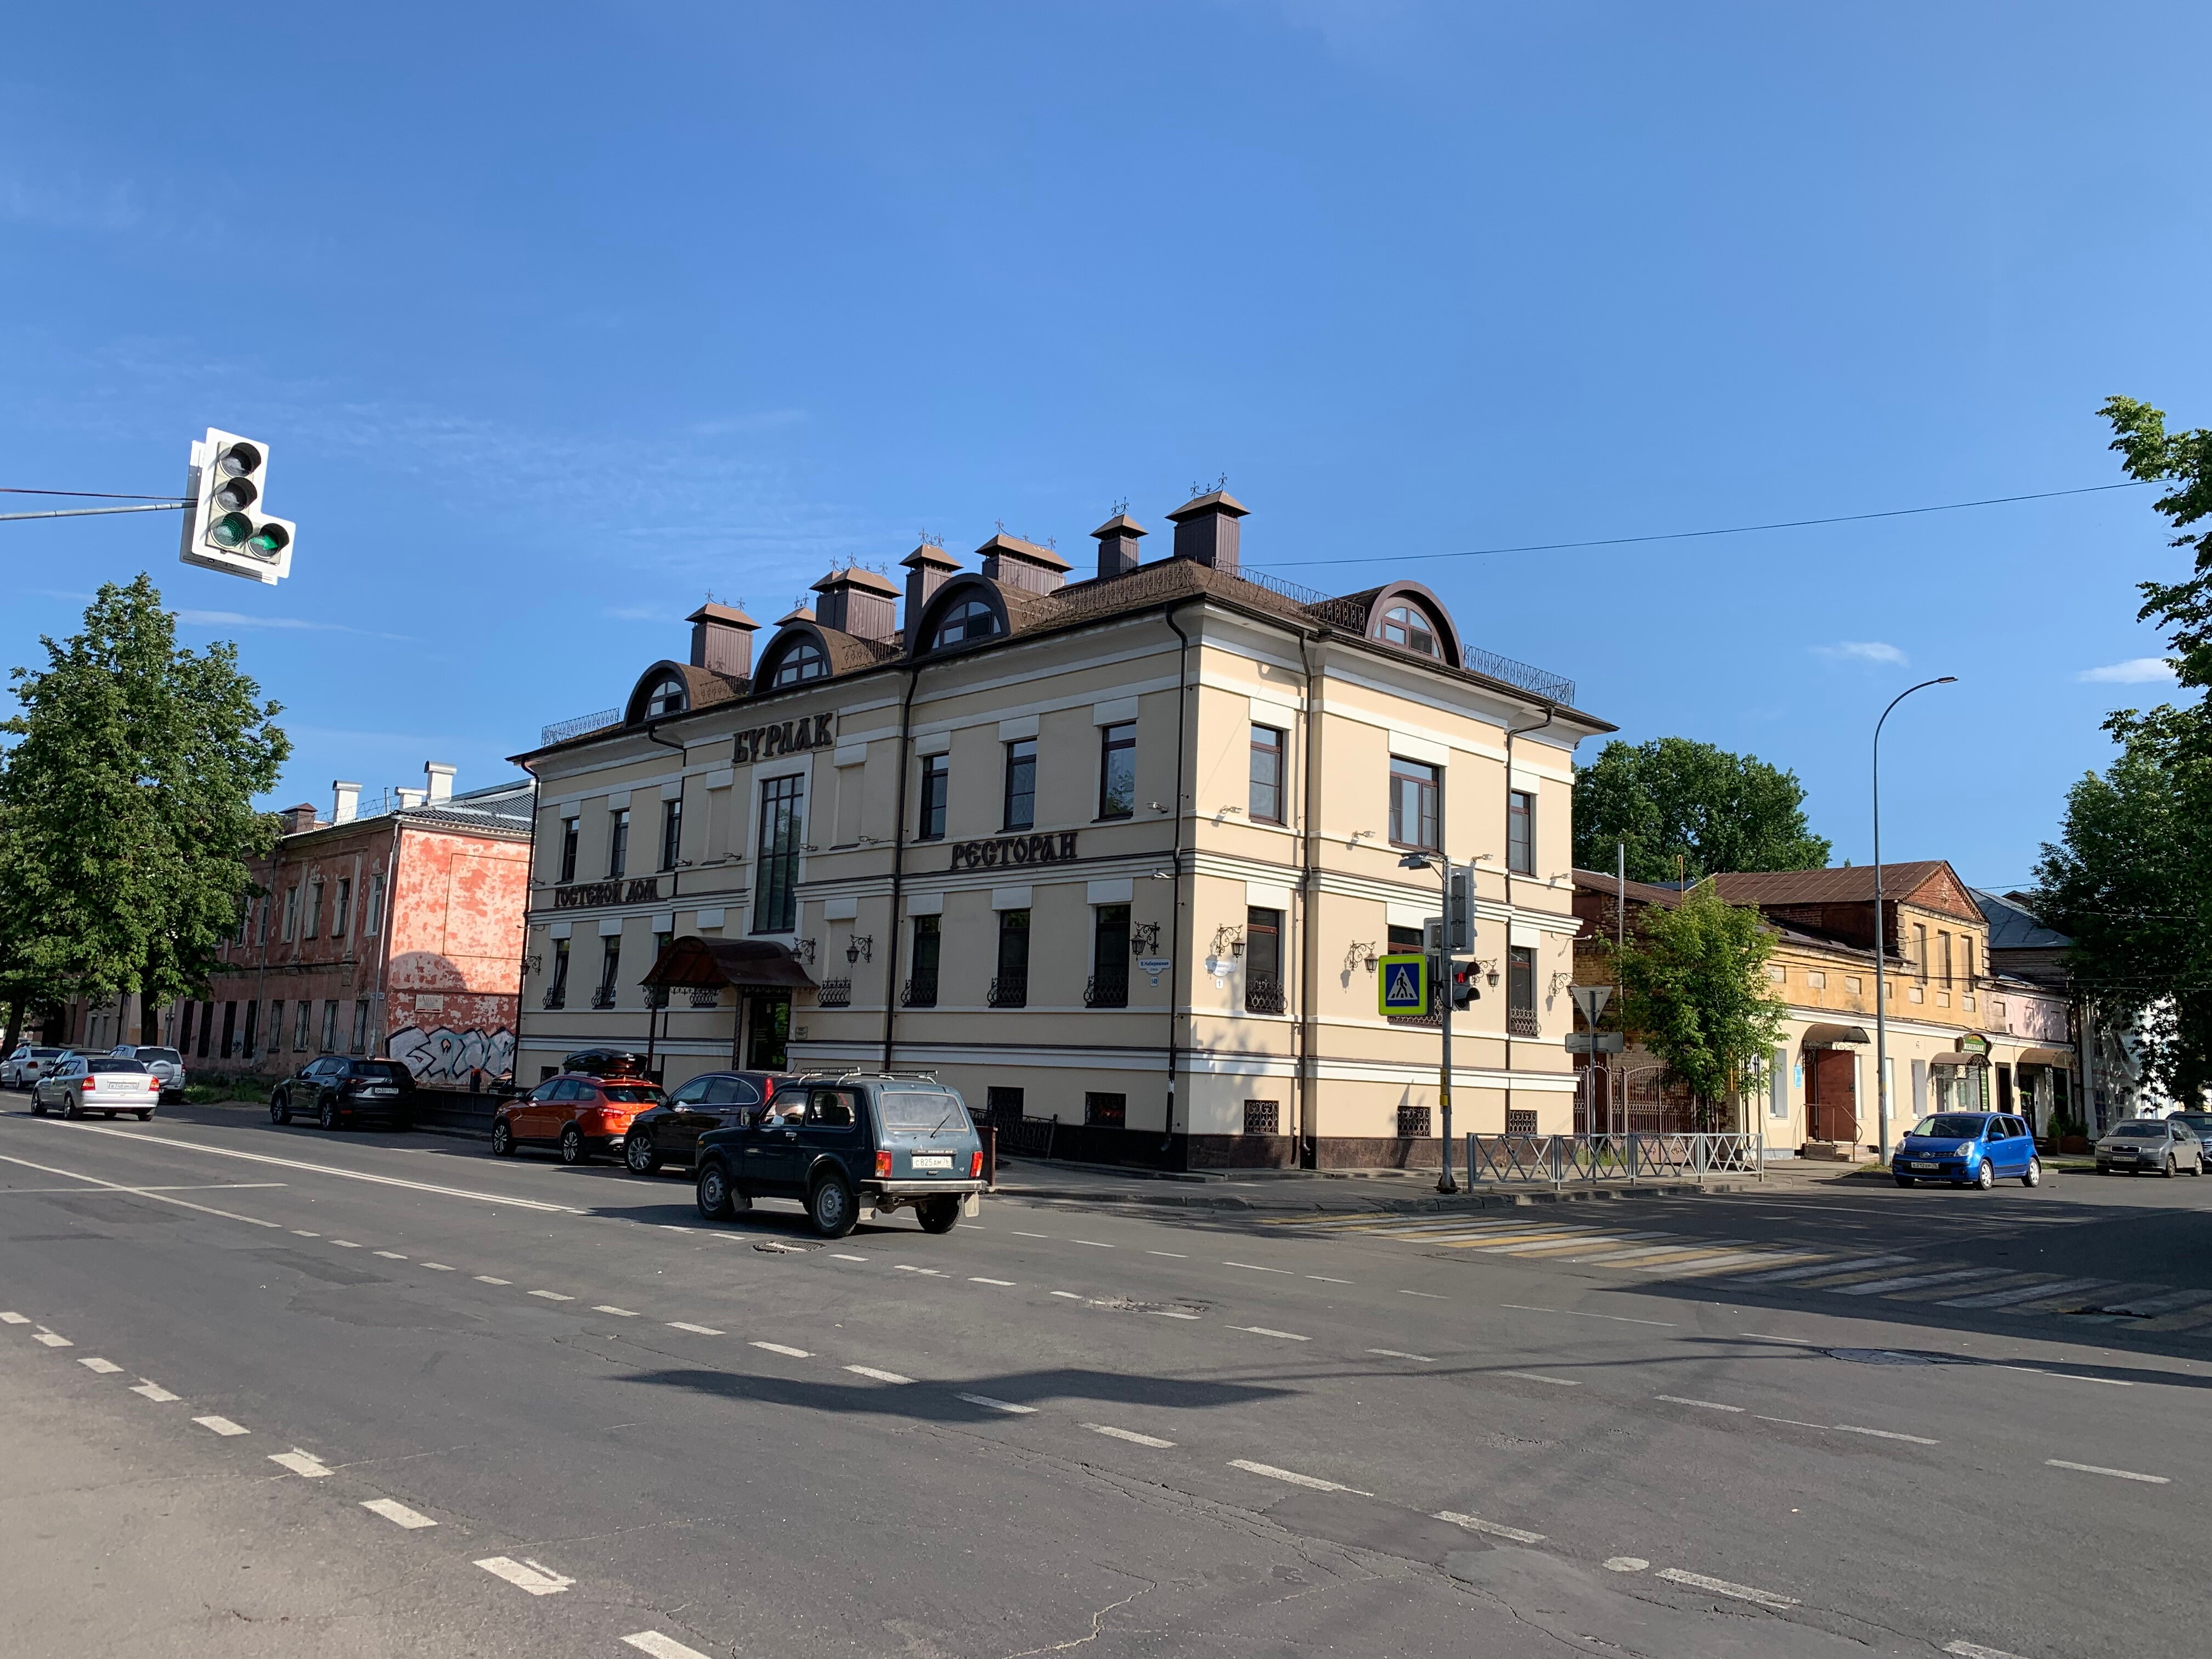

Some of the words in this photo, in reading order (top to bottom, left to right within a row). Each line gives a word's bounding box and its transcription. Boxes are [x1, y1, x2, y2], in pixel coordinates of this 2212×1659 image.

[732, 713, 832, 763] БУРЛАК
[950, 832, 1077, 869] РЕСТОРАН
[554, 878, 623, 907] ГОСТЕВОЙ
[626, 878, 658, 903] ДОМ
